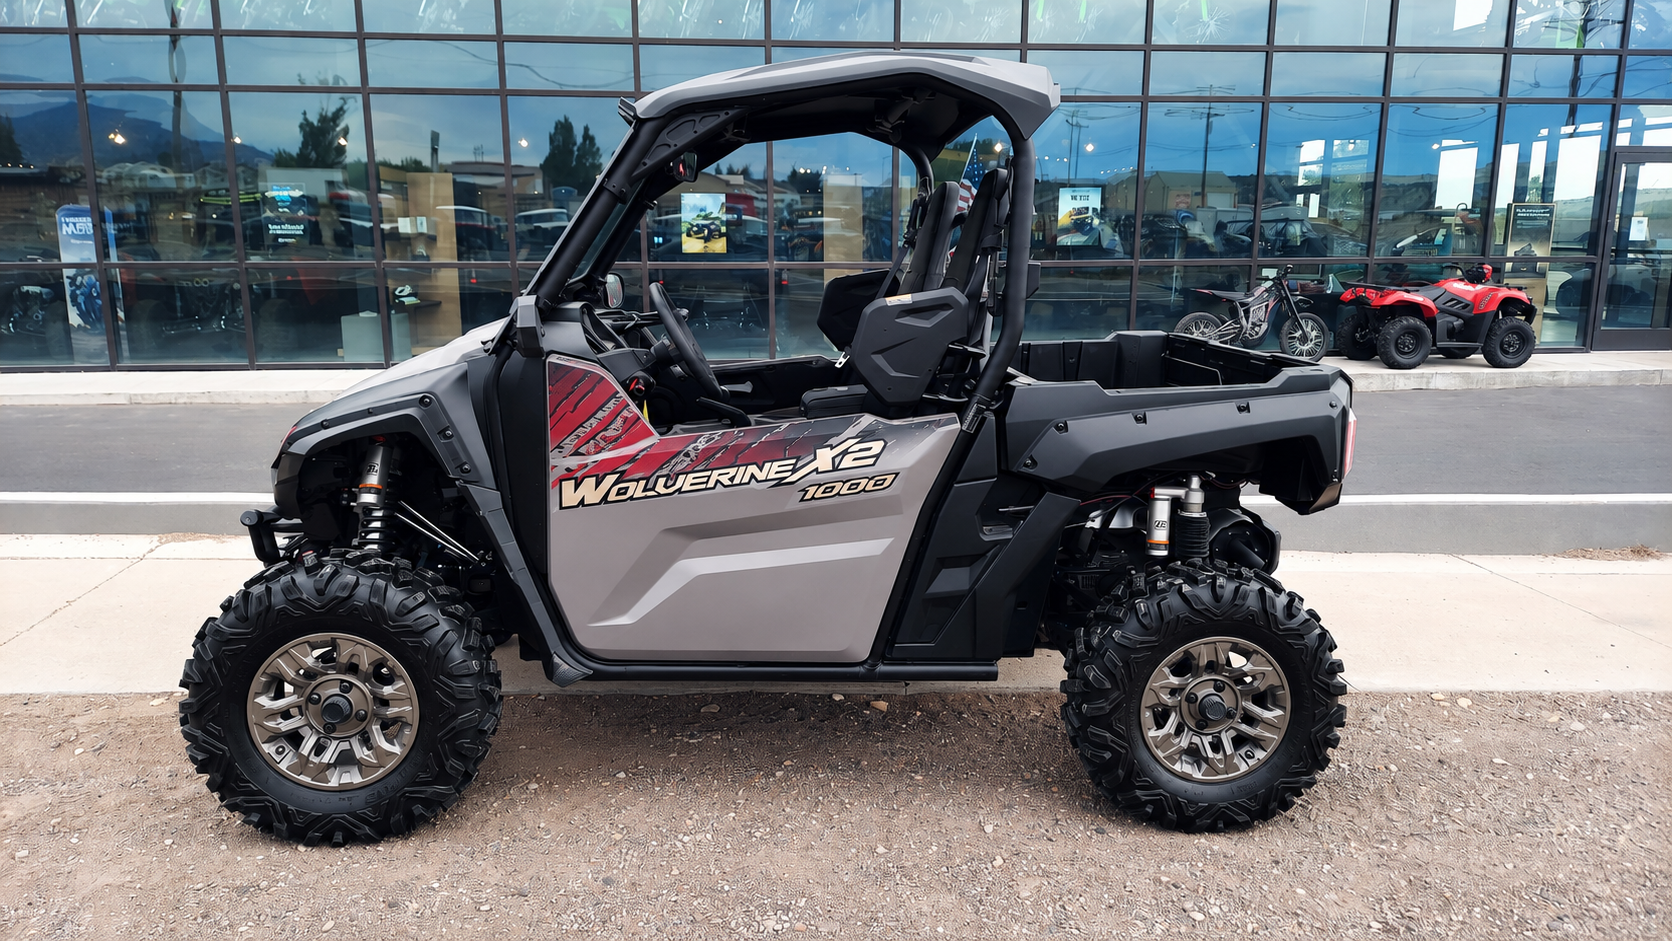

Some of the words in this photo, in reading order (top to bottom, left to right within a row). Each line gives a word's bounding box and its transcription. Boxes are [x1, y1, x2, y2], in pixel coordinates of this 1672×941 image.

[560, 457, 799, 509] WOLVERINE
[778, 437, 887, 485] X2
[801, 473, 898, 501] 1000
